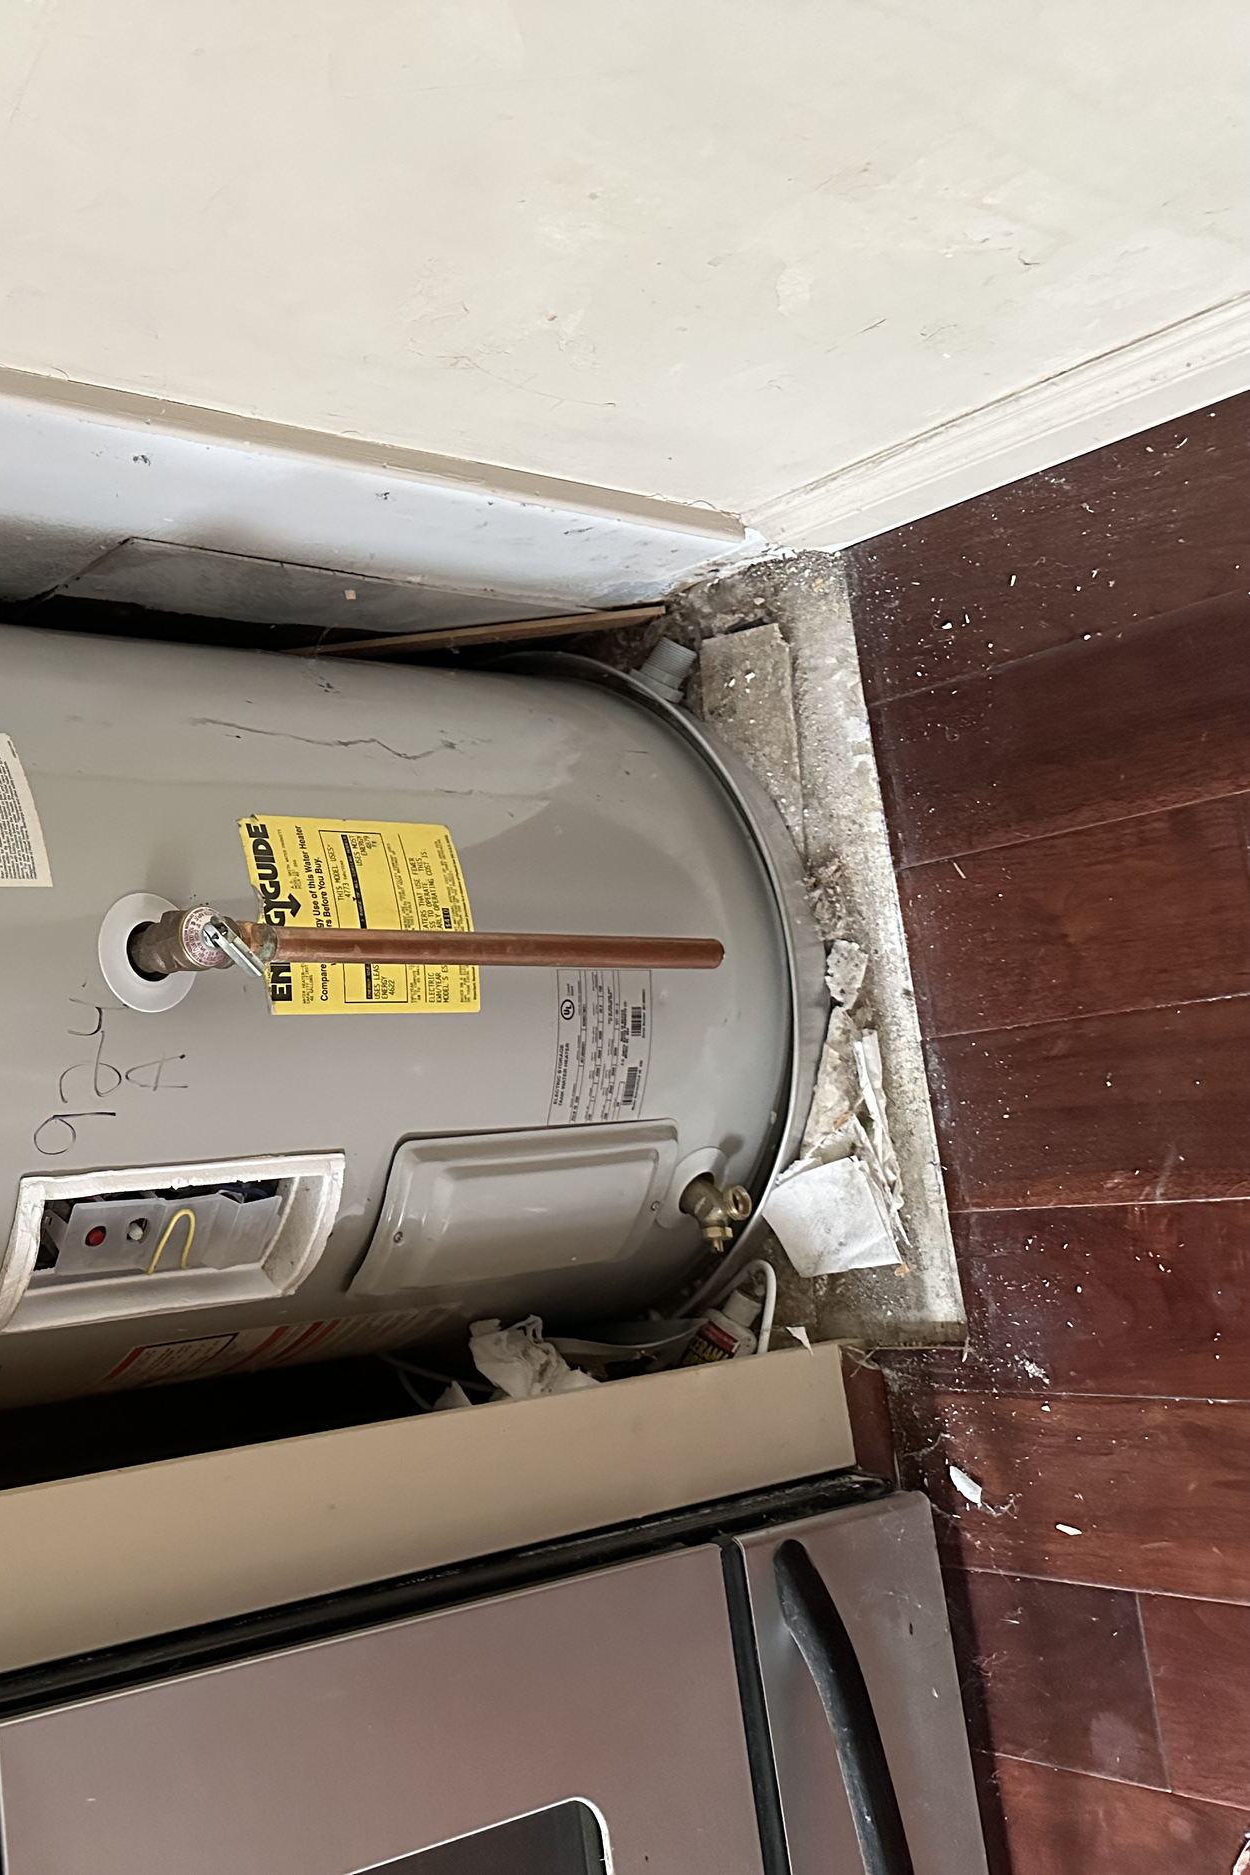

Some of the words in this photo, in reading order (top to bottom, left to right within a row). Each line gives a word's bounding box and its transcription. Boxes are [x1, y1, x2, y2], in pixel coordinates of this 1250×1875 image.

[295, 825, 307, 850] Heater
[349, 834, 359, 850] MOST
[357, 834, 368, 856] ENERGY
[302, 851, 313, 873] Water
[314, 856, 324, 874] Buy.
[353, 851, 363, 867] USES
[409, 857, 419, 875] FEWER
[416, 857, 425, 872] THIS
[331, 865, 342, 884] MODEL
[424, 861, 433, 877] COST
[307, 874, 316, 889] this
[317, 875, 326, 891] You
[343, 882, 352, 898] 4773
[414, 879, 422, 890] USE
[310, 890, 318, 899] of
[336, 886, 345, 901] THIS
[416, 892, 426, 907] THAT
[429, 877, 440, 911] OPERATING
[245, 822, 293, 1002] ENGYGUIDE
[313, 900, 322, 916] Use
[320, 891, 331, 917] Before
[427, 909, 435, 918] TO
[372, 963, 381, 981] LEAS
[321, 963, 330, 1002] Compare
[381, 975, 389, 1000] ENERGY
[388, 979, 396, 996] 4622
[428, 972, 436, 1003] ELECTRIC
[556, 1043, 565, 1074] STORAGE
[561, 1042, 570, 1068] HEATER
[560, 1068, 569, 1090] WATER
[552, 1075, 563, 1106] ELECTRIC
[557, 1090, 566, 1107] TANK
